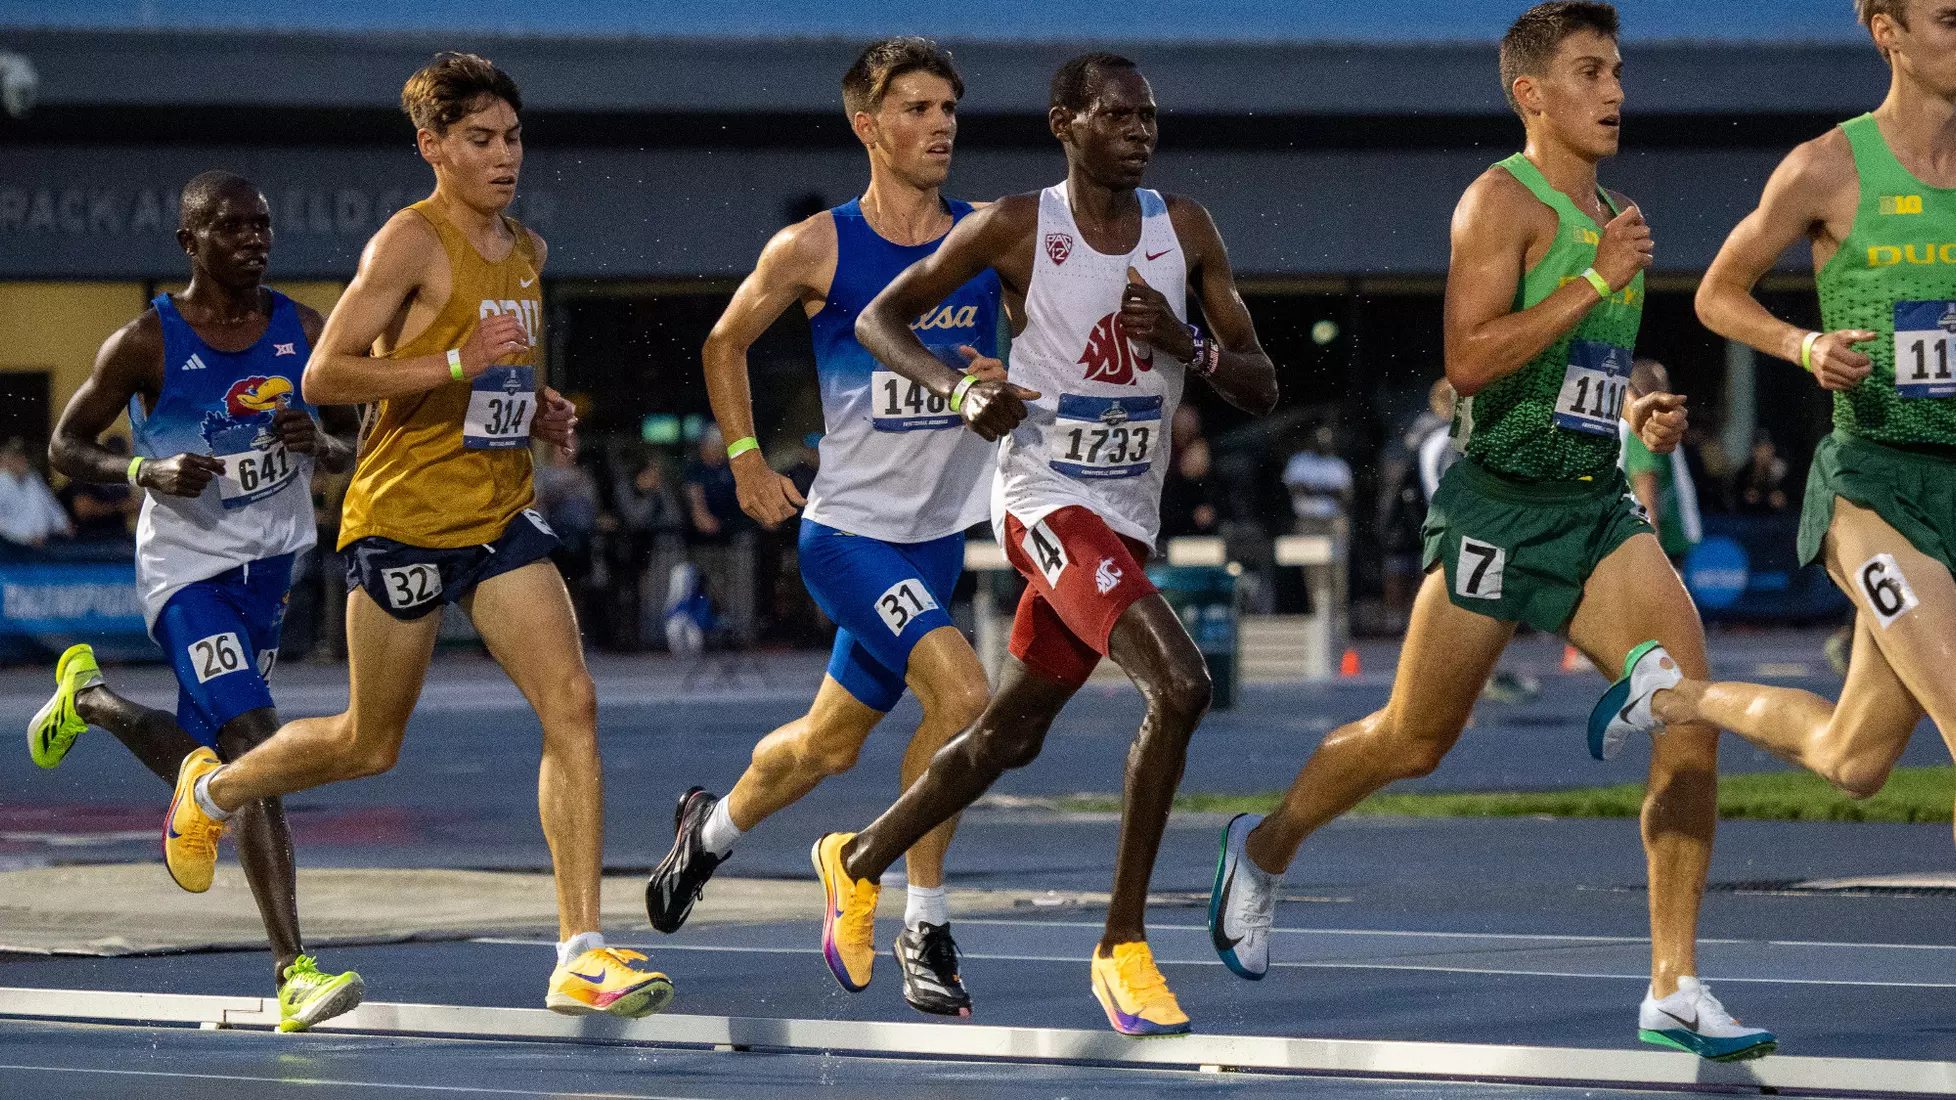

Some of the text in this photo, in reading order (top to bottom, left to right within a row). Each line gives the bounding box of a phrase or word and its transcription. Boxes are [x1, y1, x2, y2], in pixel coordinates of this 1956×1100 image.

[908, 305, 979, 331] lsa
[485, 399, 527, 435] 314
[884, 379, 957, 415] 148
[1065, 426, 1150, 463] 1733
[239, 446, 290, 491] 641
[1030, 526, 1063, 576] 4
[1465, 543, 1497, 594] 7
[390, 566, 434, 606] 32
[881, 584, 924, 629] 31
[1863, 562, 1905, 617] 6
[195, 635, 238, 678] 26
